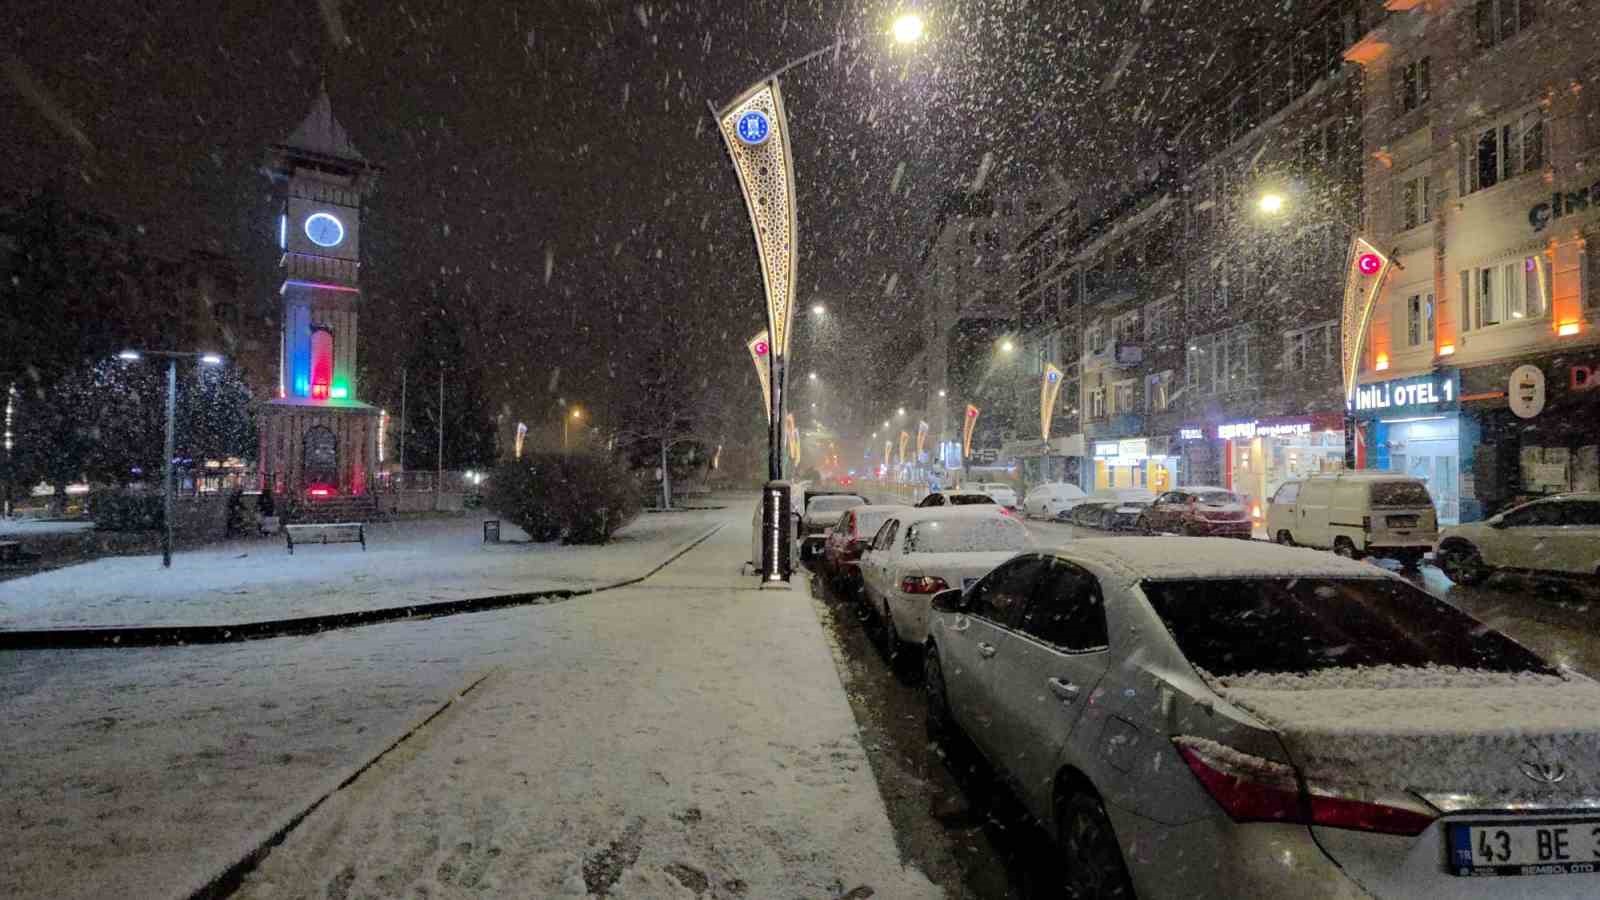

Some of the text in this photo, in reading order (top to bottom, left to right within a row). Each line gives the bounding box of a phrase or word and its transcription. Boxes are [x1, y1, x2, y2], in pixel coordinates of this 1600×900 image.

[1347, 379, 1453, 411] İNİLİ OTEL 1
[1457, 849, 1472, 861] TR
[1479, 830, 1512, 862] 43
[1537, 829, 1570, 861] BE
[1570, 864, 1594, 873] OTO
